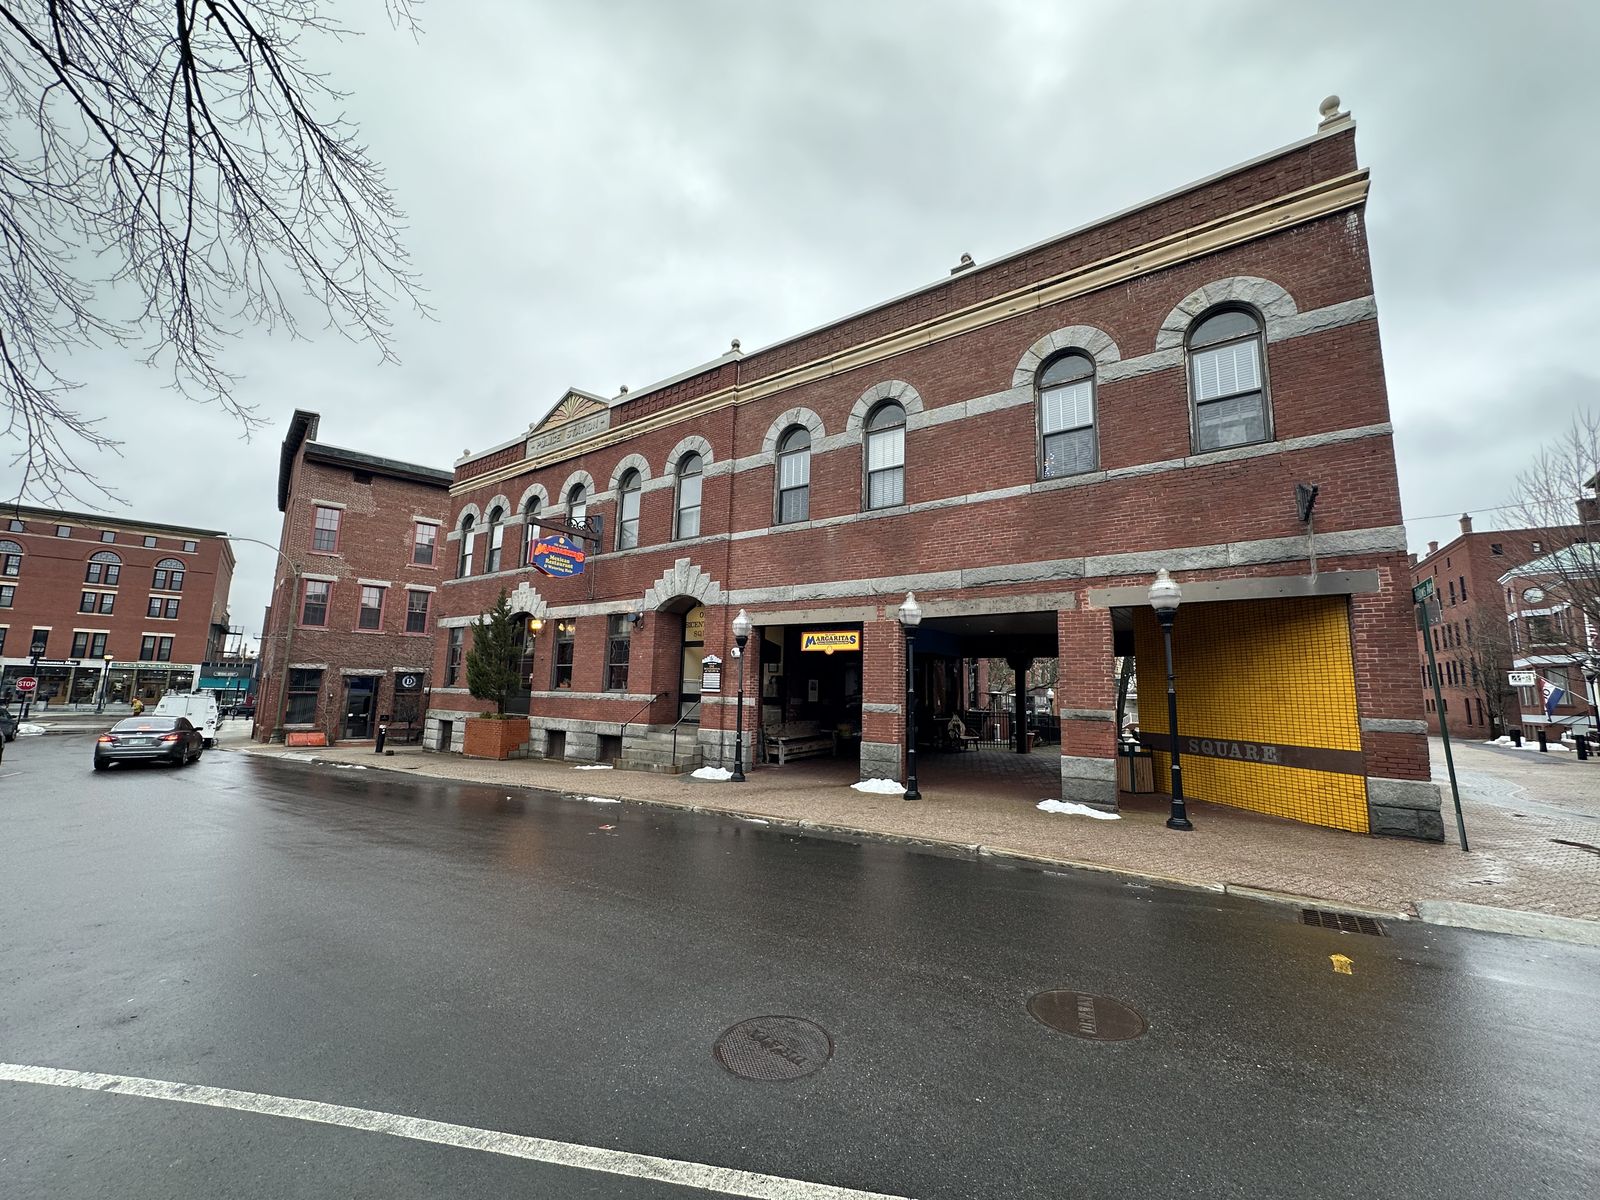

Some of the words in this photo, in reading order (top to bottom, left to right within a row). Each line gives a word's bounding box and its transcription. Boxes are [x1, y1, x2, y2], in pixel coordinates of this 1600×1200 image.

[536, 432, 562, 450] POLICE
[566, 419, 599, 440] STATION
[1188, 739, 1278, 763] SQUARE
